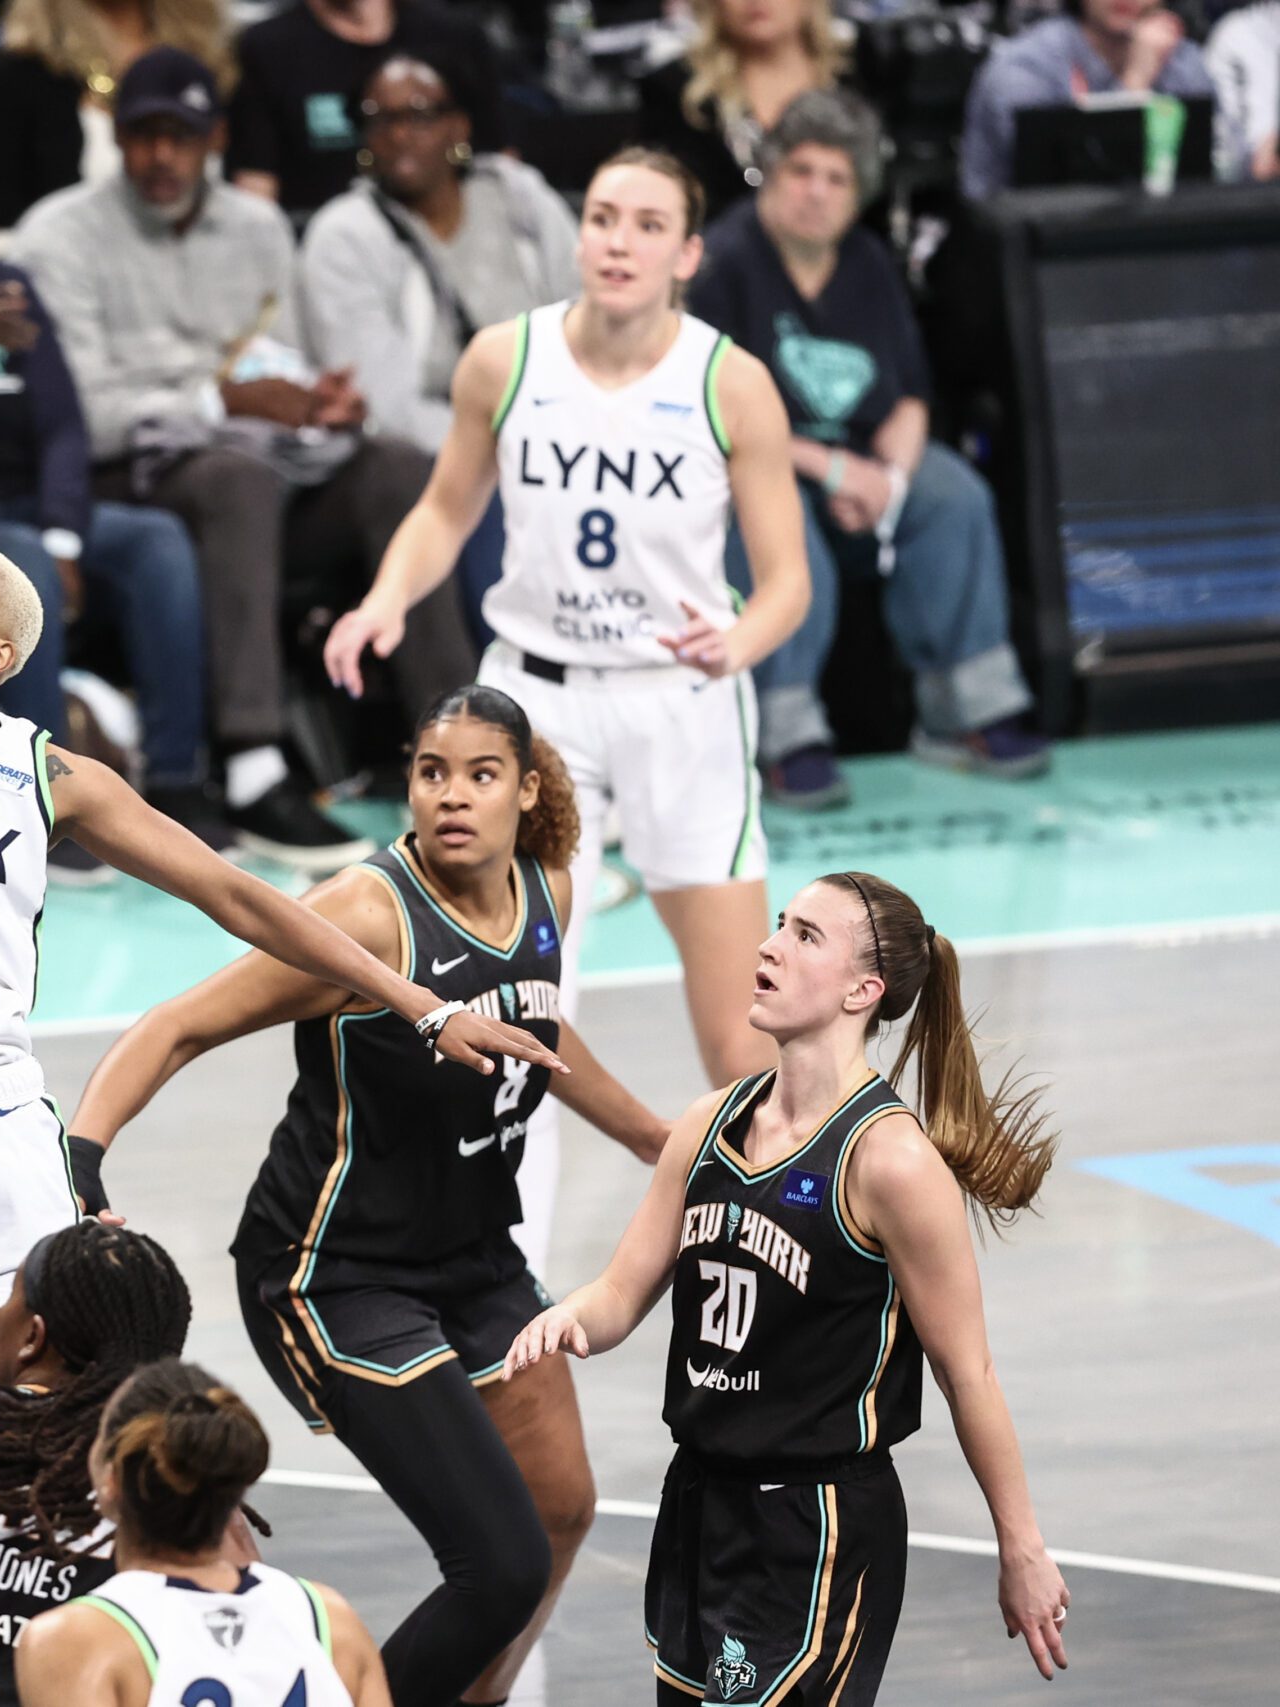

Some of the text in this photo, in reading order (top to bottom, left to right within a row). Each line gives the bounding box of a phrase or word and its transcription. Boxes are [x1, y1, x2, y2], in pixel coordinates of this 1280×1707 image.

[520, 438, 684, 499] LYNX
[577, 509, 617, 568] 8
[555, 589, 647, 612] MAYO
[786, 1191, 819, 1205] BARCLAYS
[676, 1202, 812, 1296] EW YORK
[698, 1258, 757, 1353] 20
